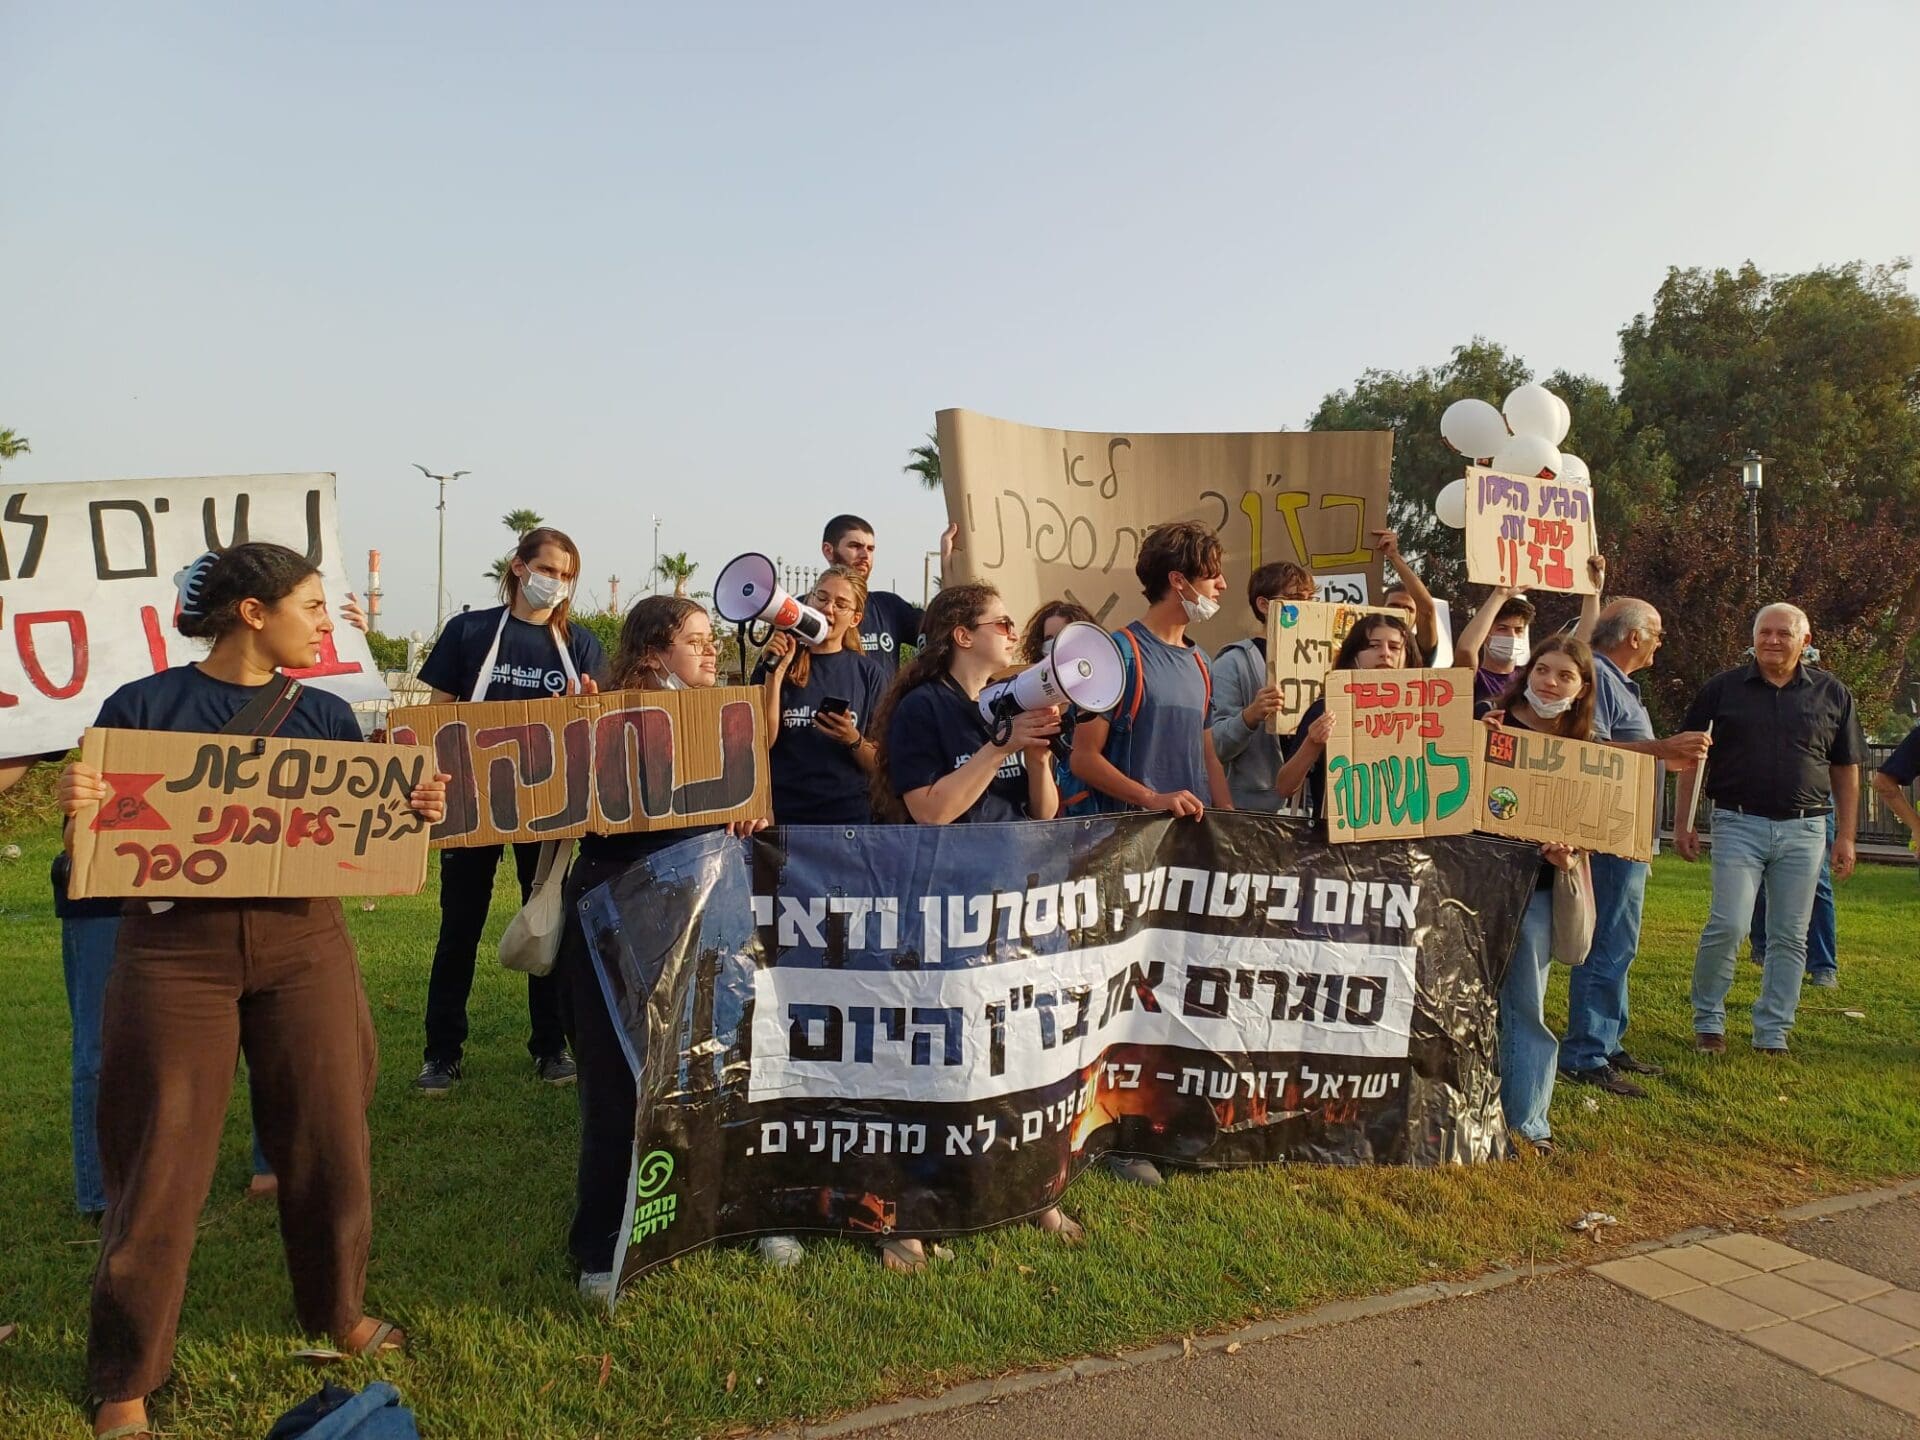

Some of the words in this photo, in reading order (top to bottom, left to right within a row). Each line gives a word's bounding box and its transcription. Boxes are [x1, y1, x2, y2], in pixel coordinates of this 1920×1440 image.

[1344, 683, 1400, 709] כבר
[1405, 679, 1453, 707] מה
[1489, 744, 1512, 761] BZN
[1491, 732, 1513, 748] FCK
[166, 744, 260, 795] את
[268, 749, 424, 802] מפנים
[390, 699, 757, 841] נחנקנ
[1329, 742, 1470, 829] לנשום?
[193, 804, 281, 845] בתי
[115, 842, 227, 887] ספר
[750, 896, 898, 949] ודאי
[919, 877, 1098, 963] מסרטן
[1114, 866, 1299, 932] ביטחוני,
[1312, 877, 1419, 928] איום
[1098, 960, 1165, 1030] את
[1183, 964, 1388, 1026] סוגרים
[788, 1003, 964, 1066] היום
[984, 984, 1093, 1077] בז"ן
[1300, 1066, 1400, 1099] ישראל
[746, 1120, 926, 1163] מתקנים.
[945, 1114, 997, 1156] לא
